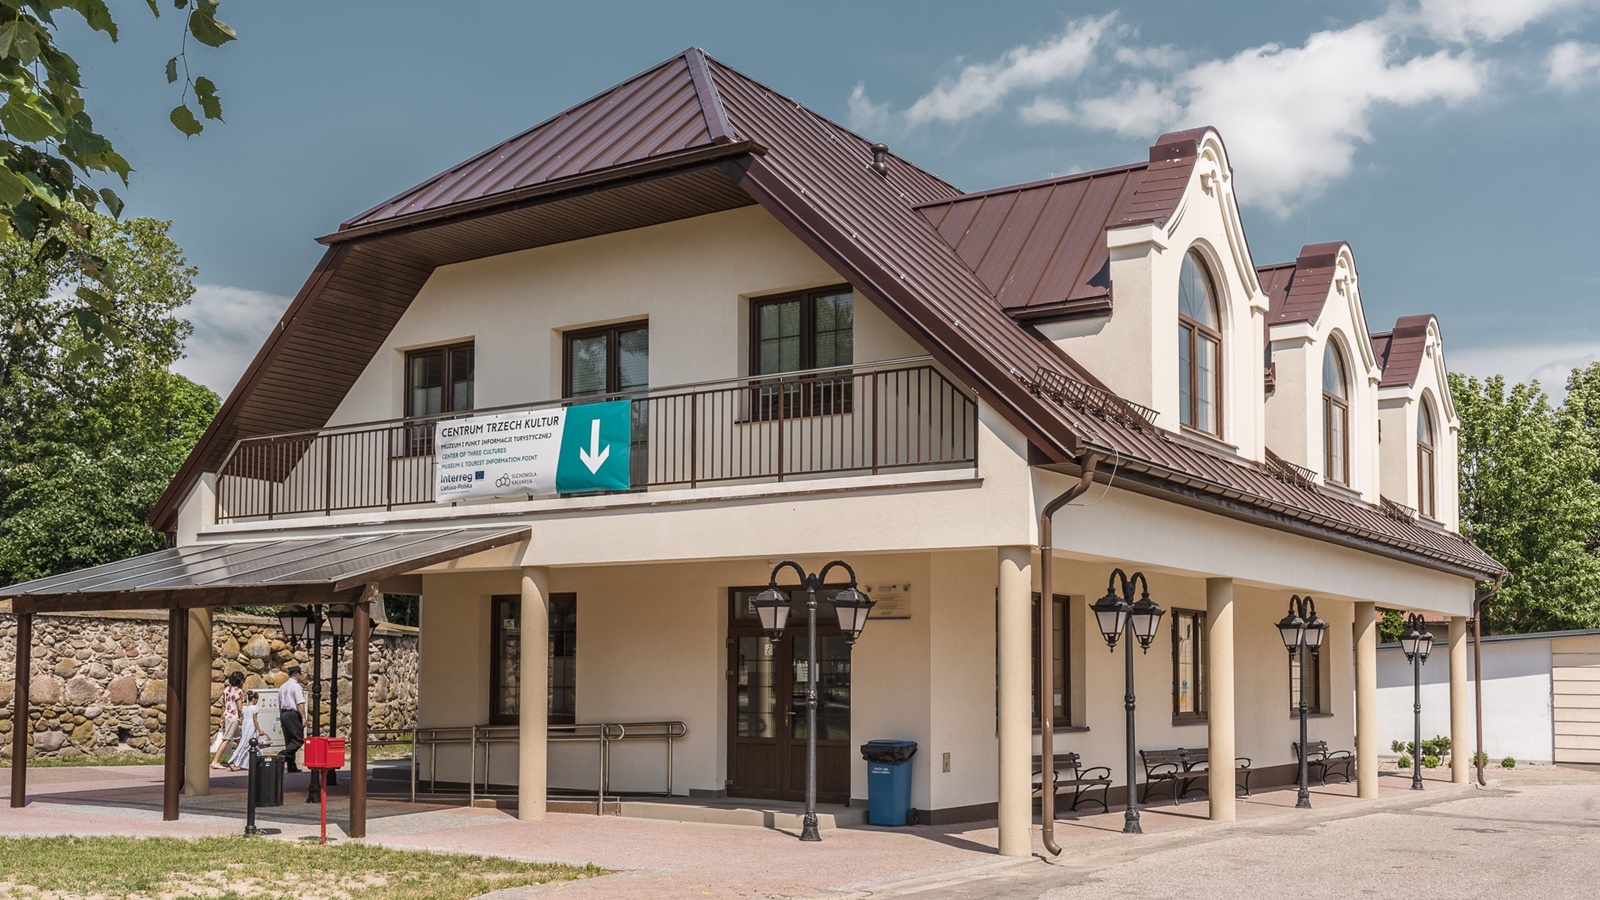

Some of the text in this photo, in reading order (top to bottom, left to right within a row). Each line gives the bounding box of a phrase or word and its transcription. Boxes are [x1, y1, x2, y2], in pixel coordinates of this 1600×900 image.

[441, 416, 560, 438] CENTRUM TRZECH KULTUR
[482, 436, 512, 446] INFORMACJI
[514, 432, 552, 442] TURYSTYCZNEJ
[482, 448, 506, 456] CULTURES
[486, 457, 520, 465] INFORMATION
[440, 473, 472, 483] Interreg
